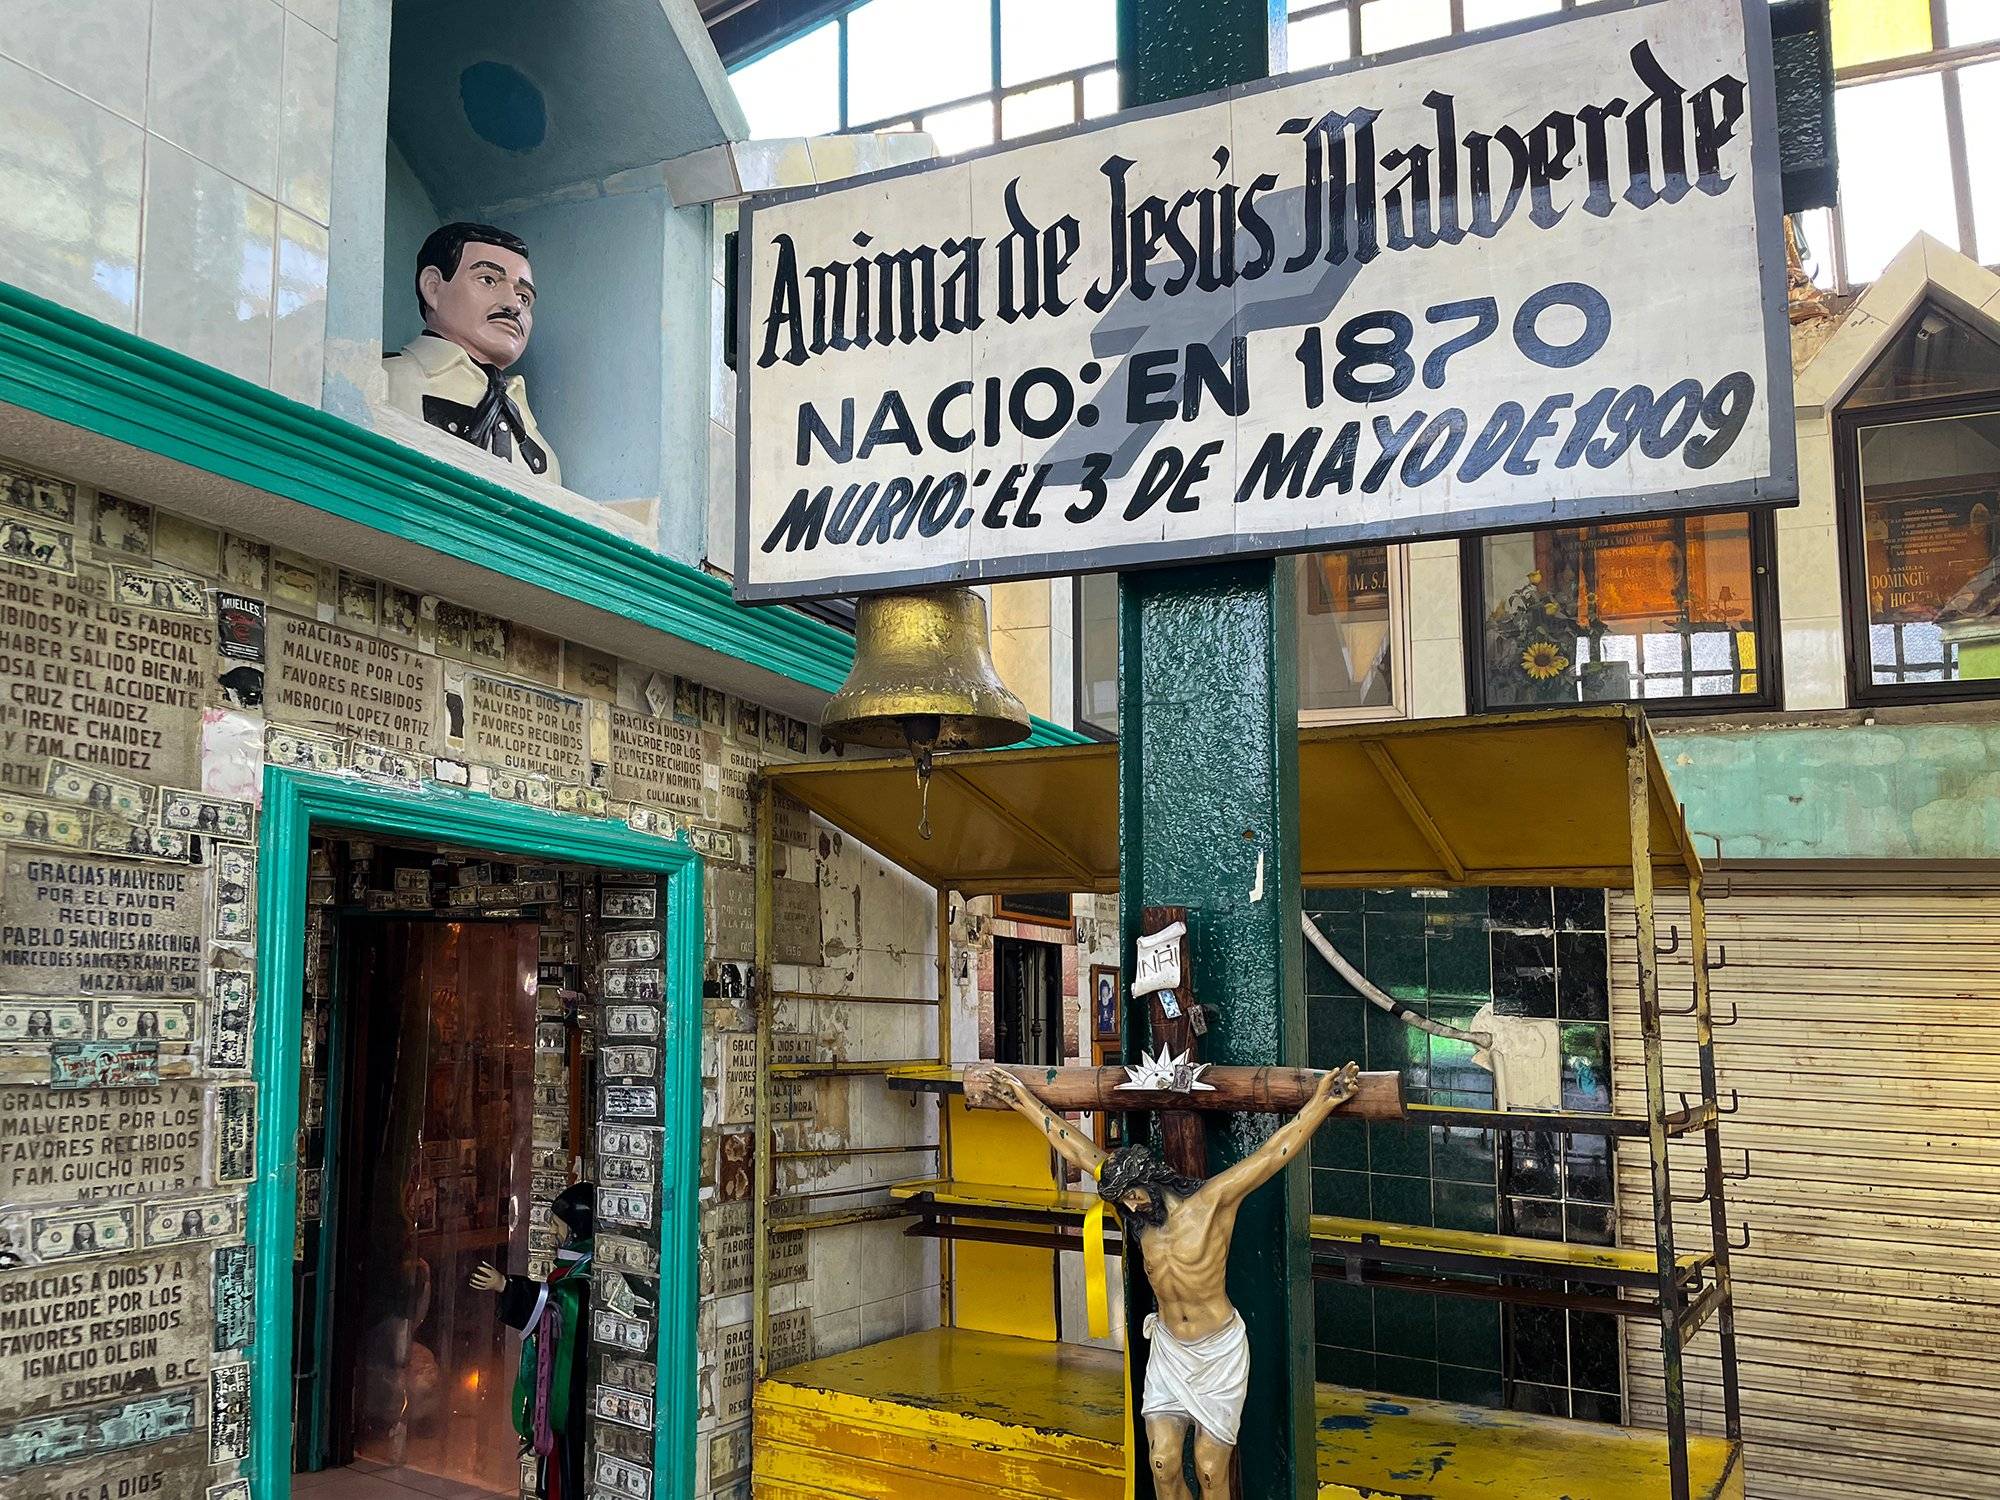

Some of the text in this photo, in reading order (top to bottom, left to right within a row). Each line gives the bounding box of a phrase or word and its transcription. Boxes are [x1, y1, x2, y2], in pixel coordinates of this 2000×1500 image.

[756, 38, 1748, 370] Anima de Jesús Malverde
[796, 281, 1612, 467] NACIO: EN 1870
[981, 463, 1053, 530] EL
[1065, 453, 1113, 525] 3
[1123, 439, 1224, 521] DE
[1235, 406, 1469, 503] MAYO
[1456, 391, 1576, 485] DE
[1557, 370, 1756, 471] 1909
[52, 594, 89, 619] POR
[95, 603, 131, 627] LOS
[138, 612, 213, 645] FABORES
[68, 620, 79, 638] Y
[84, 624, 107, 645] EN
[115, 631, 198, 665] ESPECIAL
[355, 639, 364, 653] A
[368, 641, 400, 663] DIOS
[70, 645, 136, 675] SALIDO
[283, 639, 424, 692] MALVERDE POR LOS
[10, 682, 150, 723] CRUZ CHAIDEZ
[44, 663, 68, 685] EN
[73, 670, 98, 692] EL
[104, 676, 198, 710] ACCIDENTE
[282, 665, 423, 713] FAVORES RESIBIDOS
[525, 693, 531, 704] A
[536, 696, 560, 713] DIOS
[23, 709, 162, 749] IRENE CHAIDEZ
[347, 703, 389, 728] LOPEZ
[394, 714, 429, 738] ORTIZ
[473, 695, 581, 733] MALVERDE POR LOS
[613, 713, 654, 734] GRACIAS
[657, 722, 663, 735] A
[664, 725, 685, 742] DIOS
[686, 730, 692, 742] Y
[473, 712, 583, 750] FAVORES RECIBIDOS
[506, 738, 541, 757] LOPEZ
[4, 730, 18, 750] Y
[75, 742, 151, 770] CHAIDEZ
[684, 747, 701, 760] LOS
[659, 772, 665, 783] Y
[666, 773, 701, 791] NORMITA
[28, 861, 186, 892] GRACIAS MALVERDE
[37, 886, 176, 911] POR EL FAVOR
[59, 908, 152, 927] RECIBIDO
[2, 927, 201, 953] PABLO SANCHES ARECHIGA
[133, 955, 200, 973] RAMIREZ
[80, 973, 196, 992] MAZATLAN SIN
[2, 1086, 199, 1111] GRACIAS A DIOS Y A
[1, 1109, 199, 1138] MALVERDE POR LOS
[1, 1130, 200, 1163] FAVORES RECIBIDOS
[62, 1159, 134, 1183] GUICHO
[142, 1154, 186, 1175] RIOS
[1, 1261, 183, 1301] GRACIAS A DIOS Y A
[1, 1285, 183, 1331] MALVERDE POR LOS
[0, 1309, 181, 1357] FAVORES RESIBIDOS
[773, 1316, 805, 1334] DIOS Y A
[23, 1338, 158, 1381] IGNACIO OLGIN
[118, 1471, 164, 1499] DIOS
